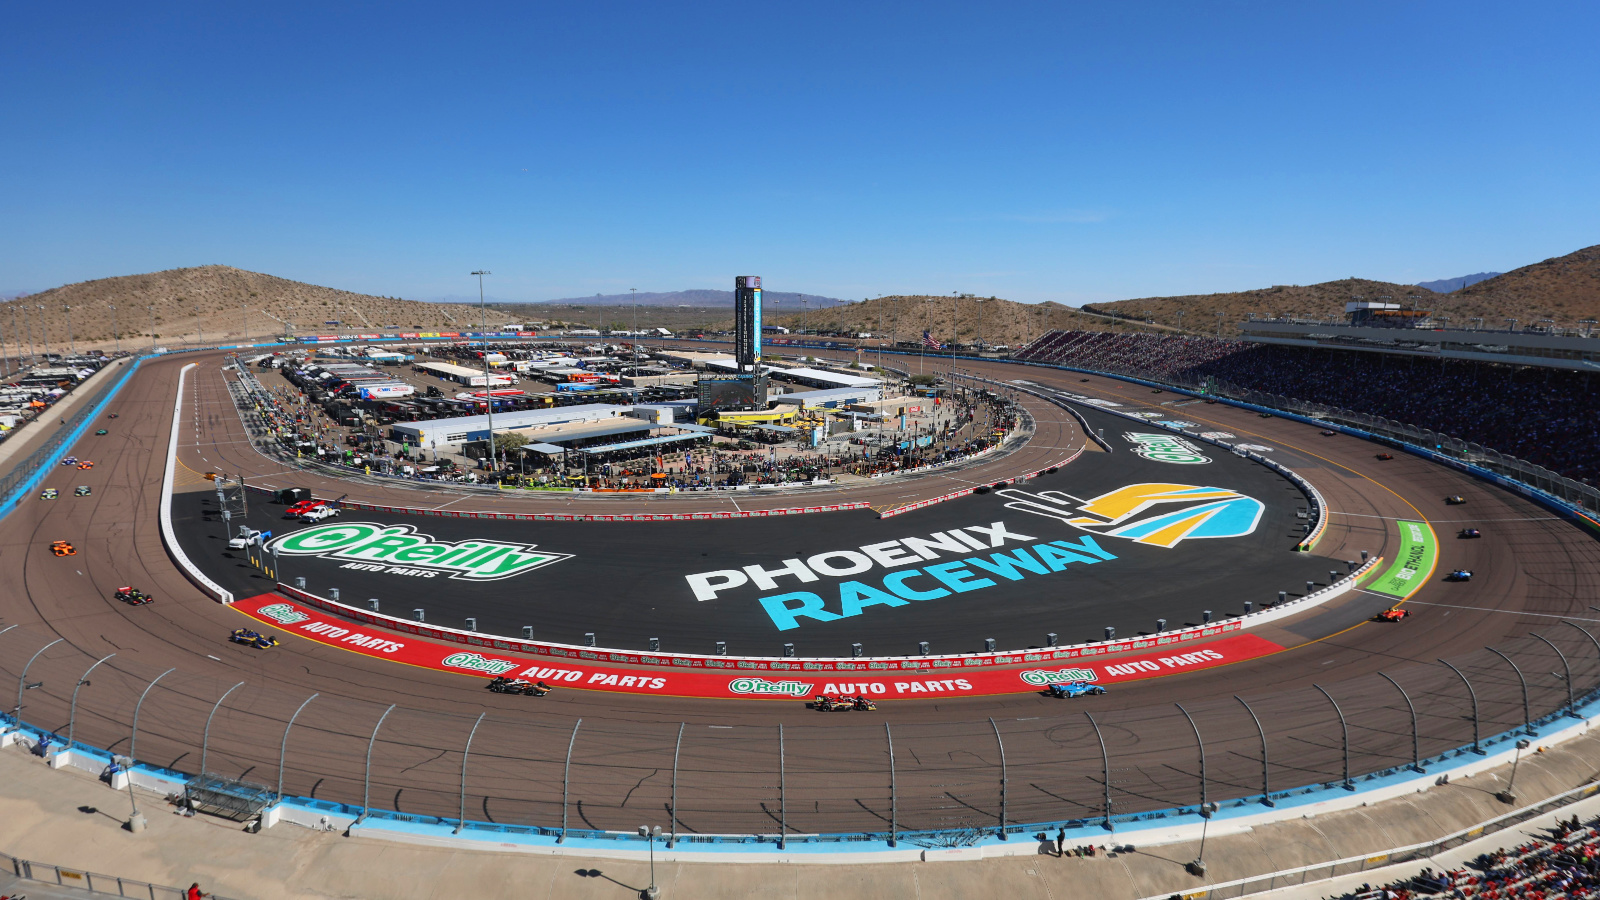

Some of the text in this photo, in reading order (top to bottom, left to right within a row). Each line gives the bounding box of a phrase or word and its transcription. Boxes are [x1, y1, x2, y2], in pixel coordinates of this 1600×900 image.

[280, 525, 552, 576] O'Reilly
[685, 521, 1038, 602] PHOENIX
[338, 562, 440, 579] AUTO PARTS
[758, 534, 1118, 631] RACEWAY
[300, 622, 350, 638] AUTO
[341, 633, 404, 653] PARTS
[446, 654, 667, 690] O'Reilly AUTO PARTS
[1024, 648, 1224, 684] O'Reilly AUTO PARTS
[732, 678, 973, 695] O'Reilly AUTO PARTS
